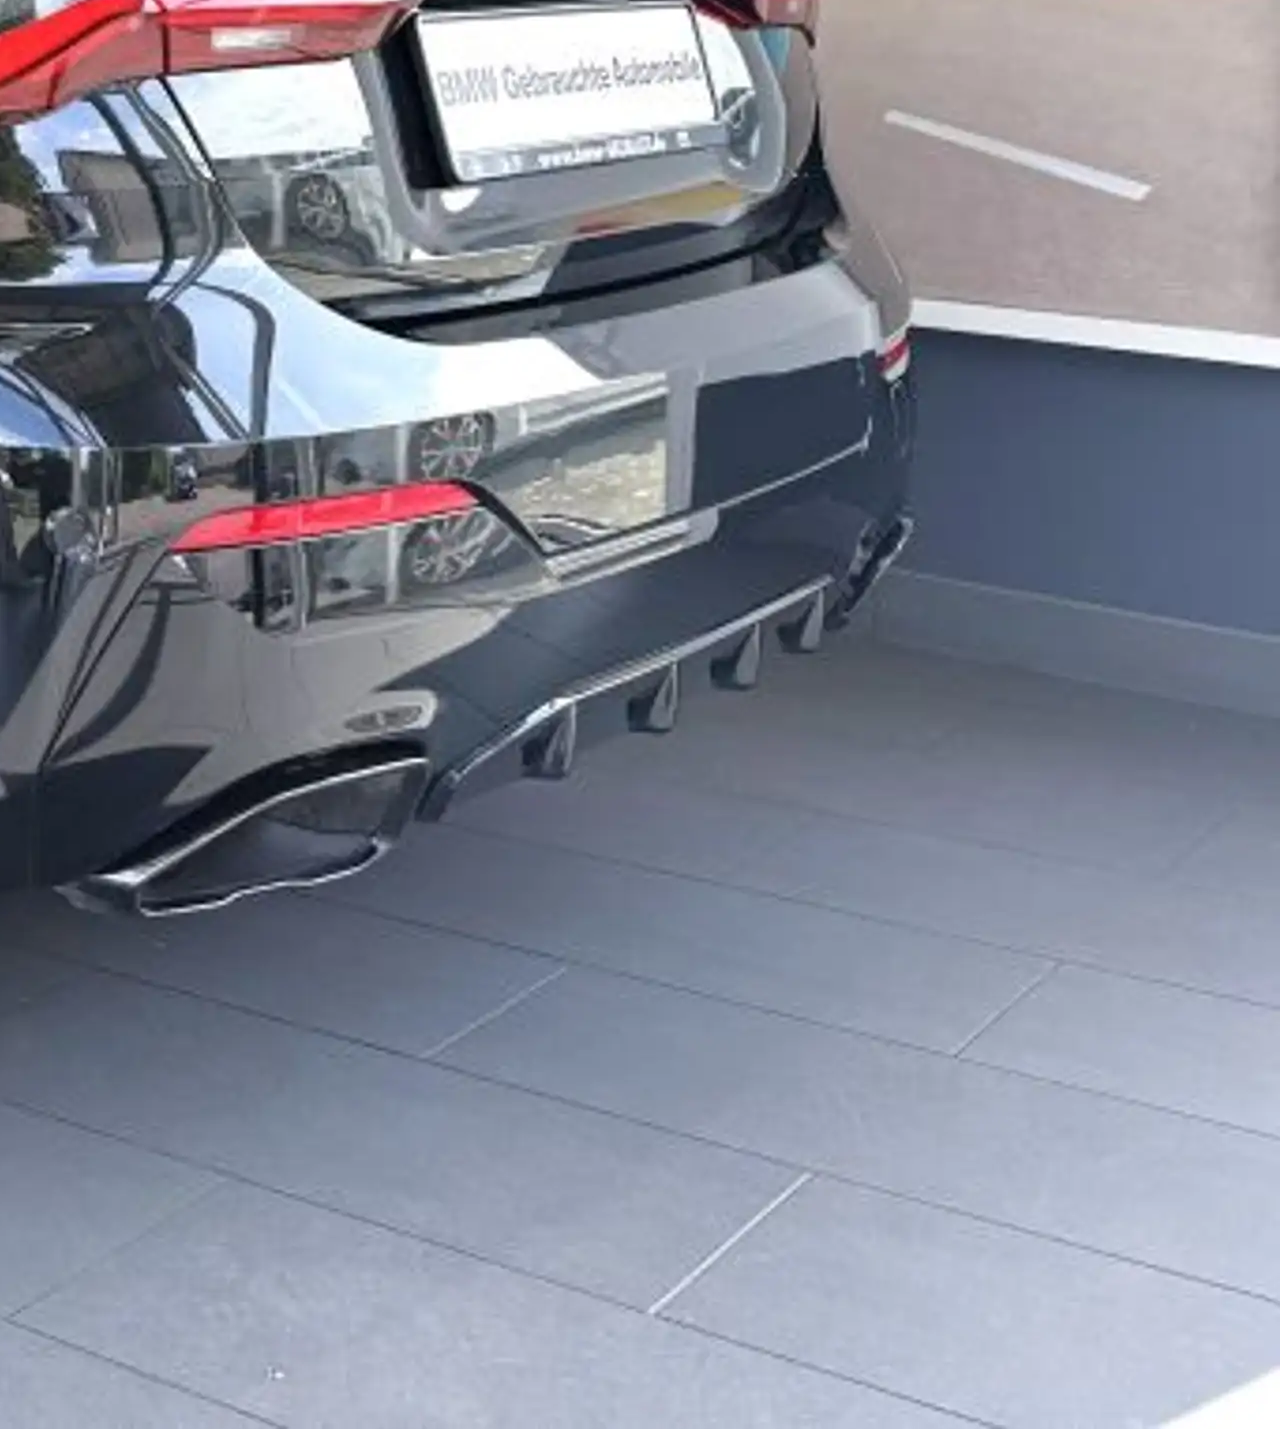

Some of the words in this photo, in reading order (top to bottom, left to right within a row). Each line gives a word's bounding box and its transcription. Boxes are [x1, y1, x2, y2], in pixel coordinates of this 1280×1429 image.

[437, 65, 498, 106] BMW
[501, 57, 611, 100] Gebrauchte
[612, 51, 703, 88] Automobile
